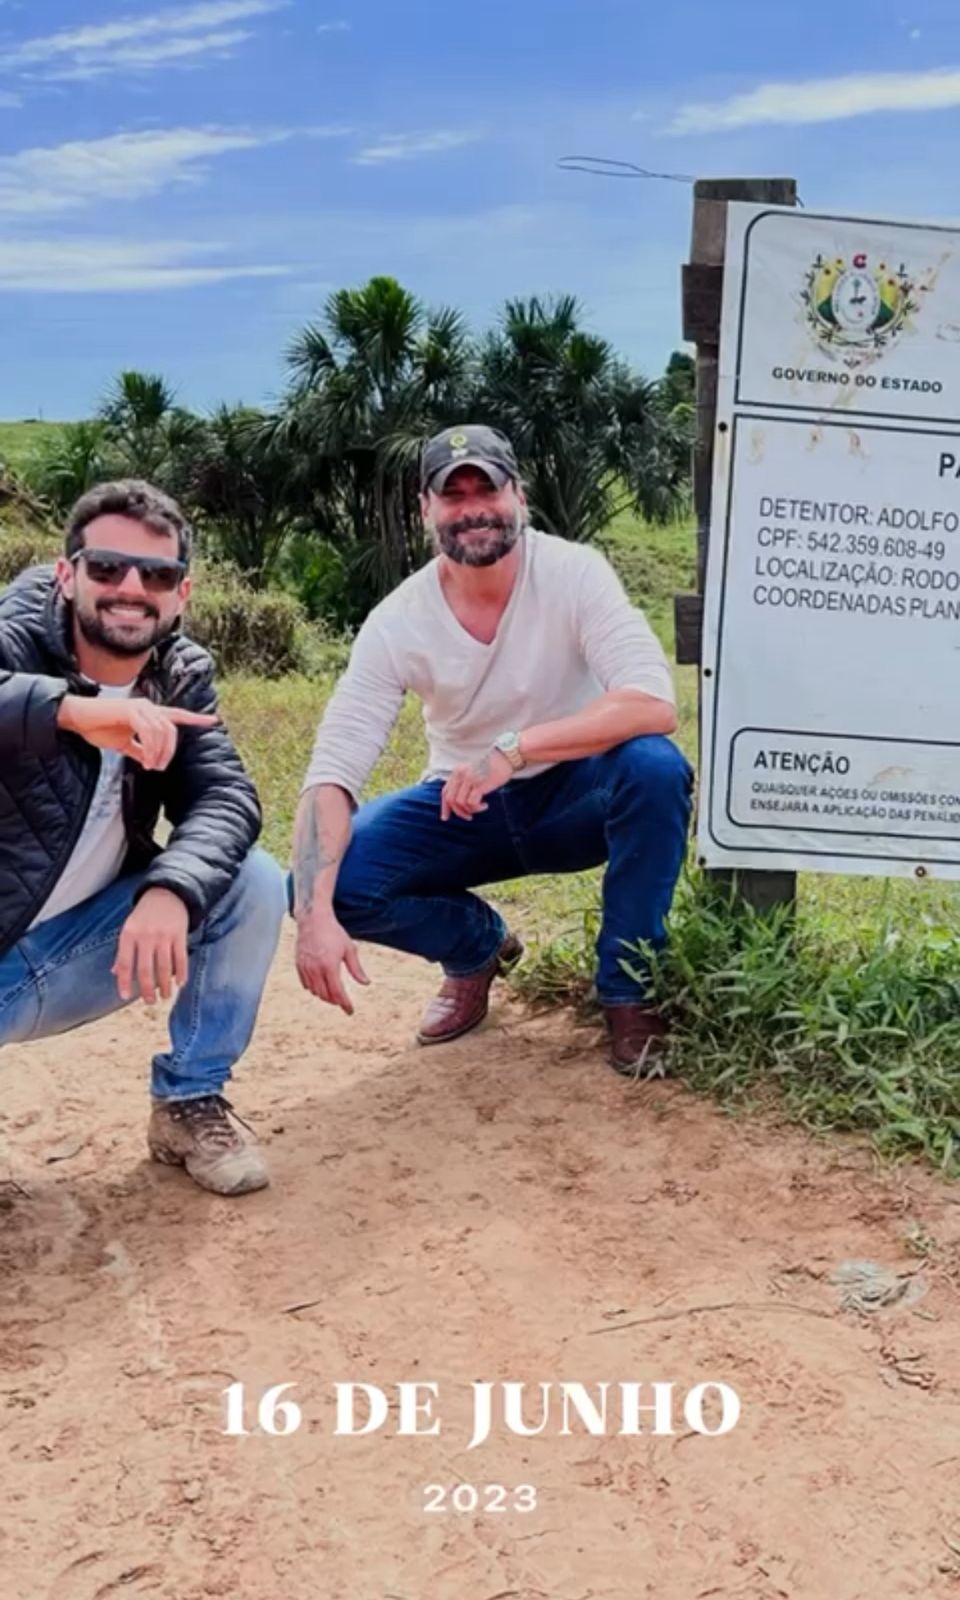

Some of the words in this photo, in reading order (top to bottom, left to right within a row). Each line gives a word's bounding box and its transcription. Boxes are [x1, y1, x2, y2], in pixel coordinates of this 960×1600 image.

[772, 367, 850, 385] GOVERNO
[855, 374, 876, 387] DO
[881, 376, 942, 394] ESTADO
[759, 497, 874, 526] DETENTOR:
[877, 508, 959, 533] ADOLFO
[757, 526, 803, 549] CPF:
[807, 532, 945, 561] 542.359.608-49
[755, 556, 898, 588] LOCALIZAÇÃO:
[753, 585, 907, 616] COORDENADAS
[754, 750, 850, 776] ATENÇÃO
[751, 781, 818, 797] QUAISQUER
[820, 786, 859, 803] AÇÕES
[861, 789, 877, 802] OU
[880, 790, 936, 806] OMISSÕES
[822, 804, 887, 820] APLICAÇÃO
[889, 808, 911, 821] DAS
